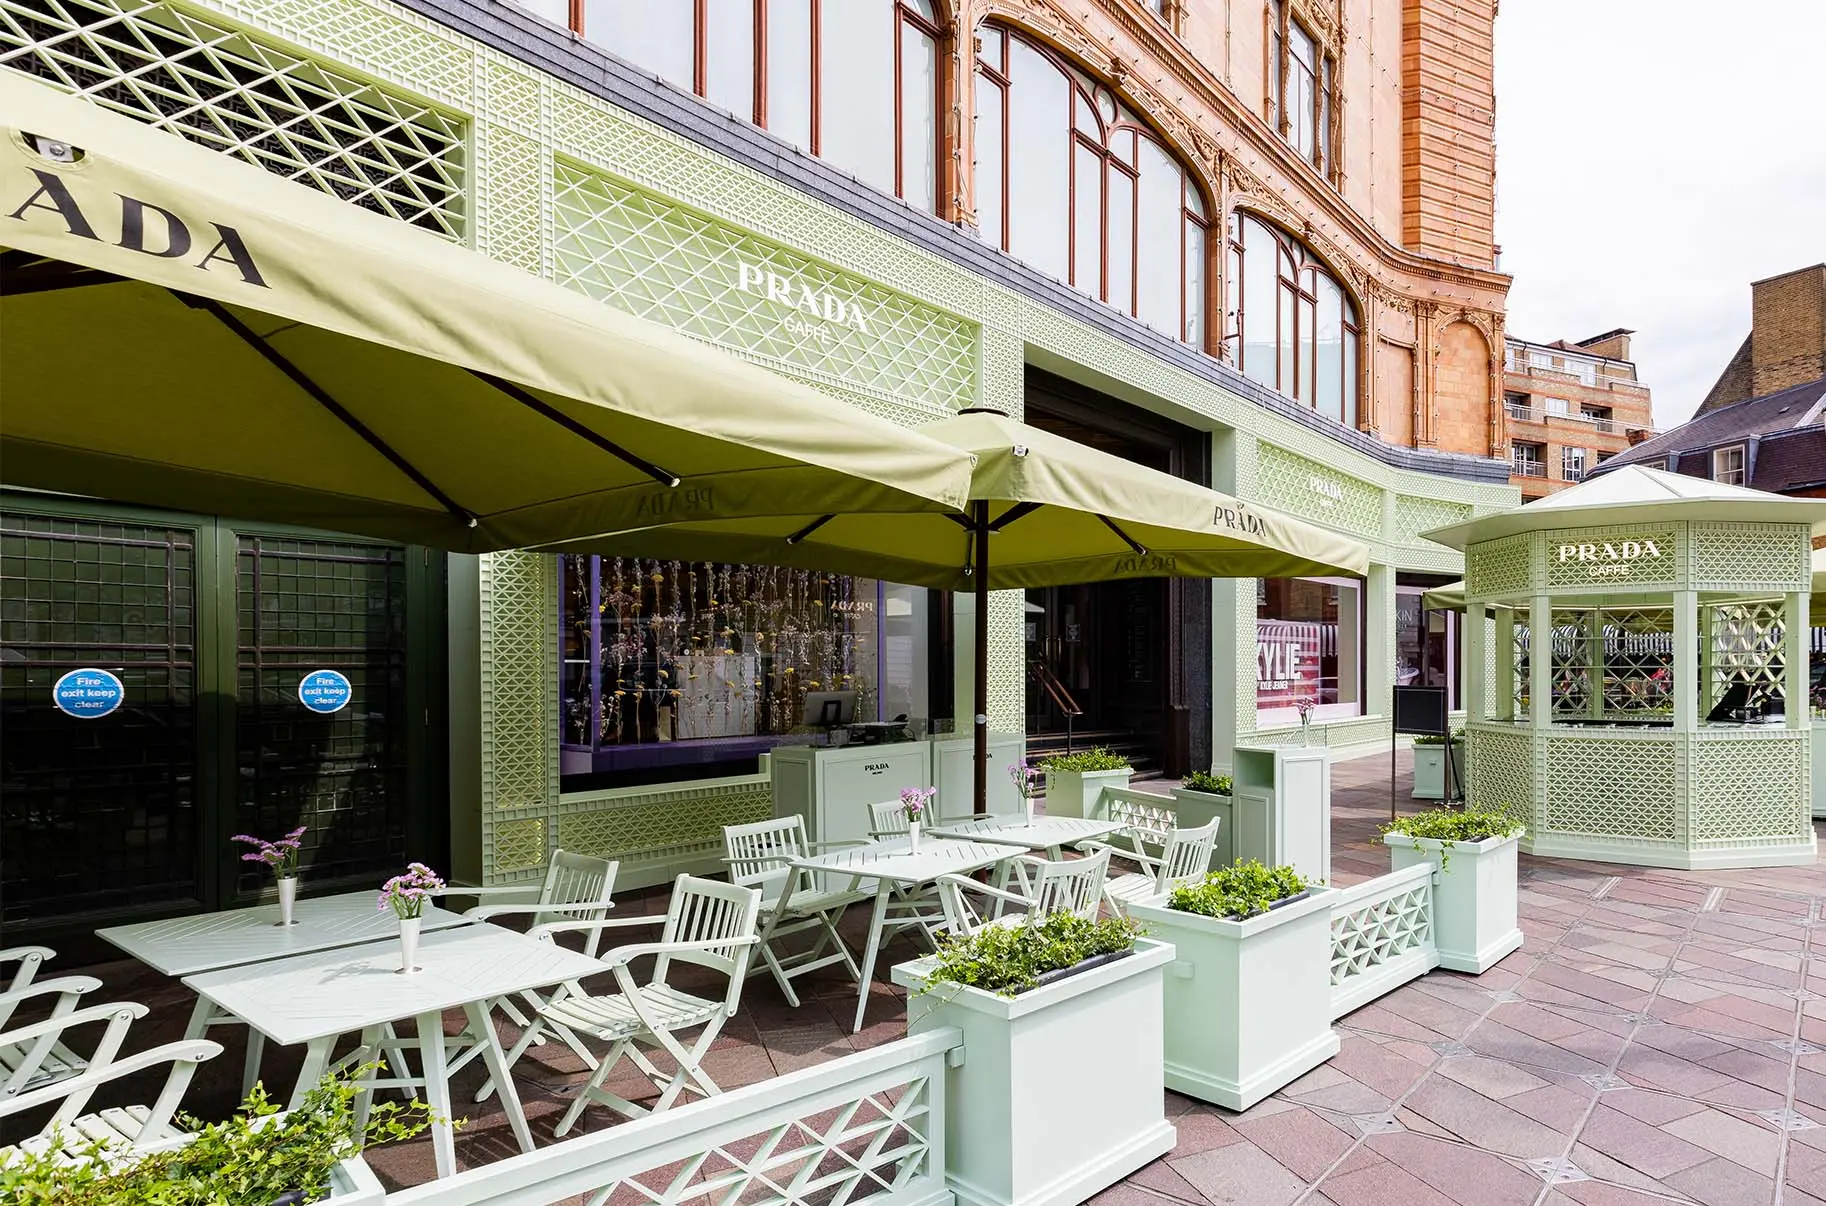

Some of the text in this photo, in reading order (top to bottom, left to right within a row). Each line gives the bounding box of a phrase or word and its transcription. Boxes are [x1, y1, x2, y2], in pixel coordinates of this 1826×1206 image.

[736, 261, 869, 334] PRADA
[1310, 476, 1344, 501] PRADA
[1213, 505, 1267, 537] PRADA
[1559, 540, 1662, 562] PRADA
[61, 688, 117, 699] exit keep
[304, 687, 346, 696] exit keep
[74, 701, 105, 709] clear
[313, 697, 337, 705] clear
[864, 763, 890, 771] PRADA
